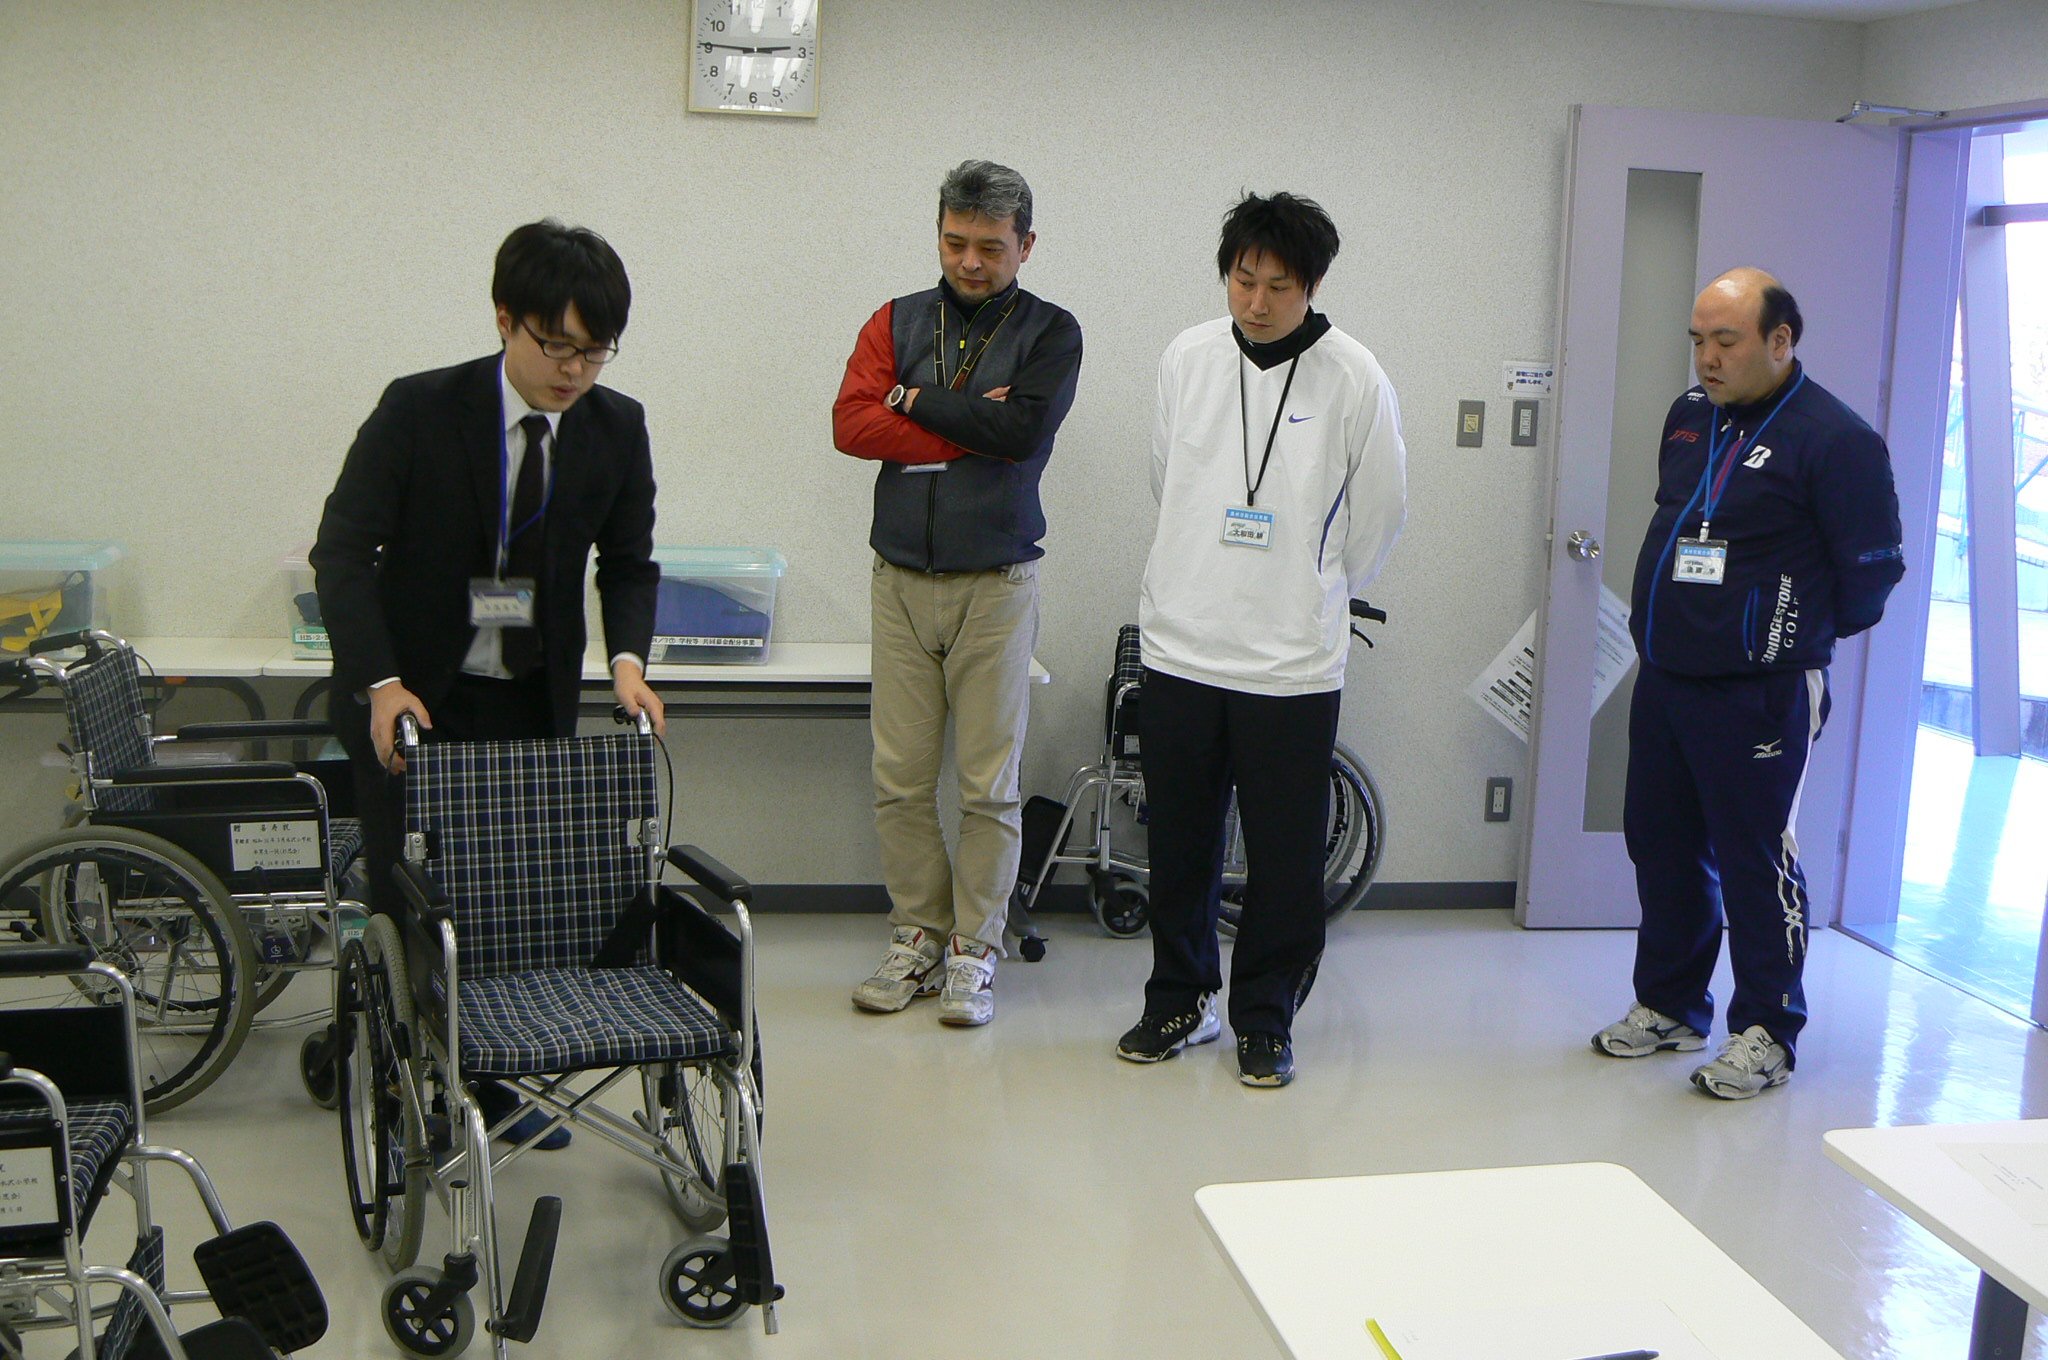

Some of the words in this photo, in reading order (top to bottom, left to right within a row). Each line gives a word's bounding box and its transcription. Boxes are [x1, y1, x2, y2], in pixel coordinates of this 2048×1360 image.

[776, 6, 782, 17] 1
[710, 20, 725, 32] 10
[792, 24, 800, 36] 2
[704, 42, 712, 54] 9
[798, 47, 806, 58] 3
[710, 66, 718, 78] 8
[790, 70, 798, 82] 4
[727, 84, 735, 95] 7
[772, 86, 781, 98] 5
[749, 92, 758, 104] 6
[1761, 573, 1792, 664] BRIDGESTONE
[1783, 597, 1799, 648] GOLF
